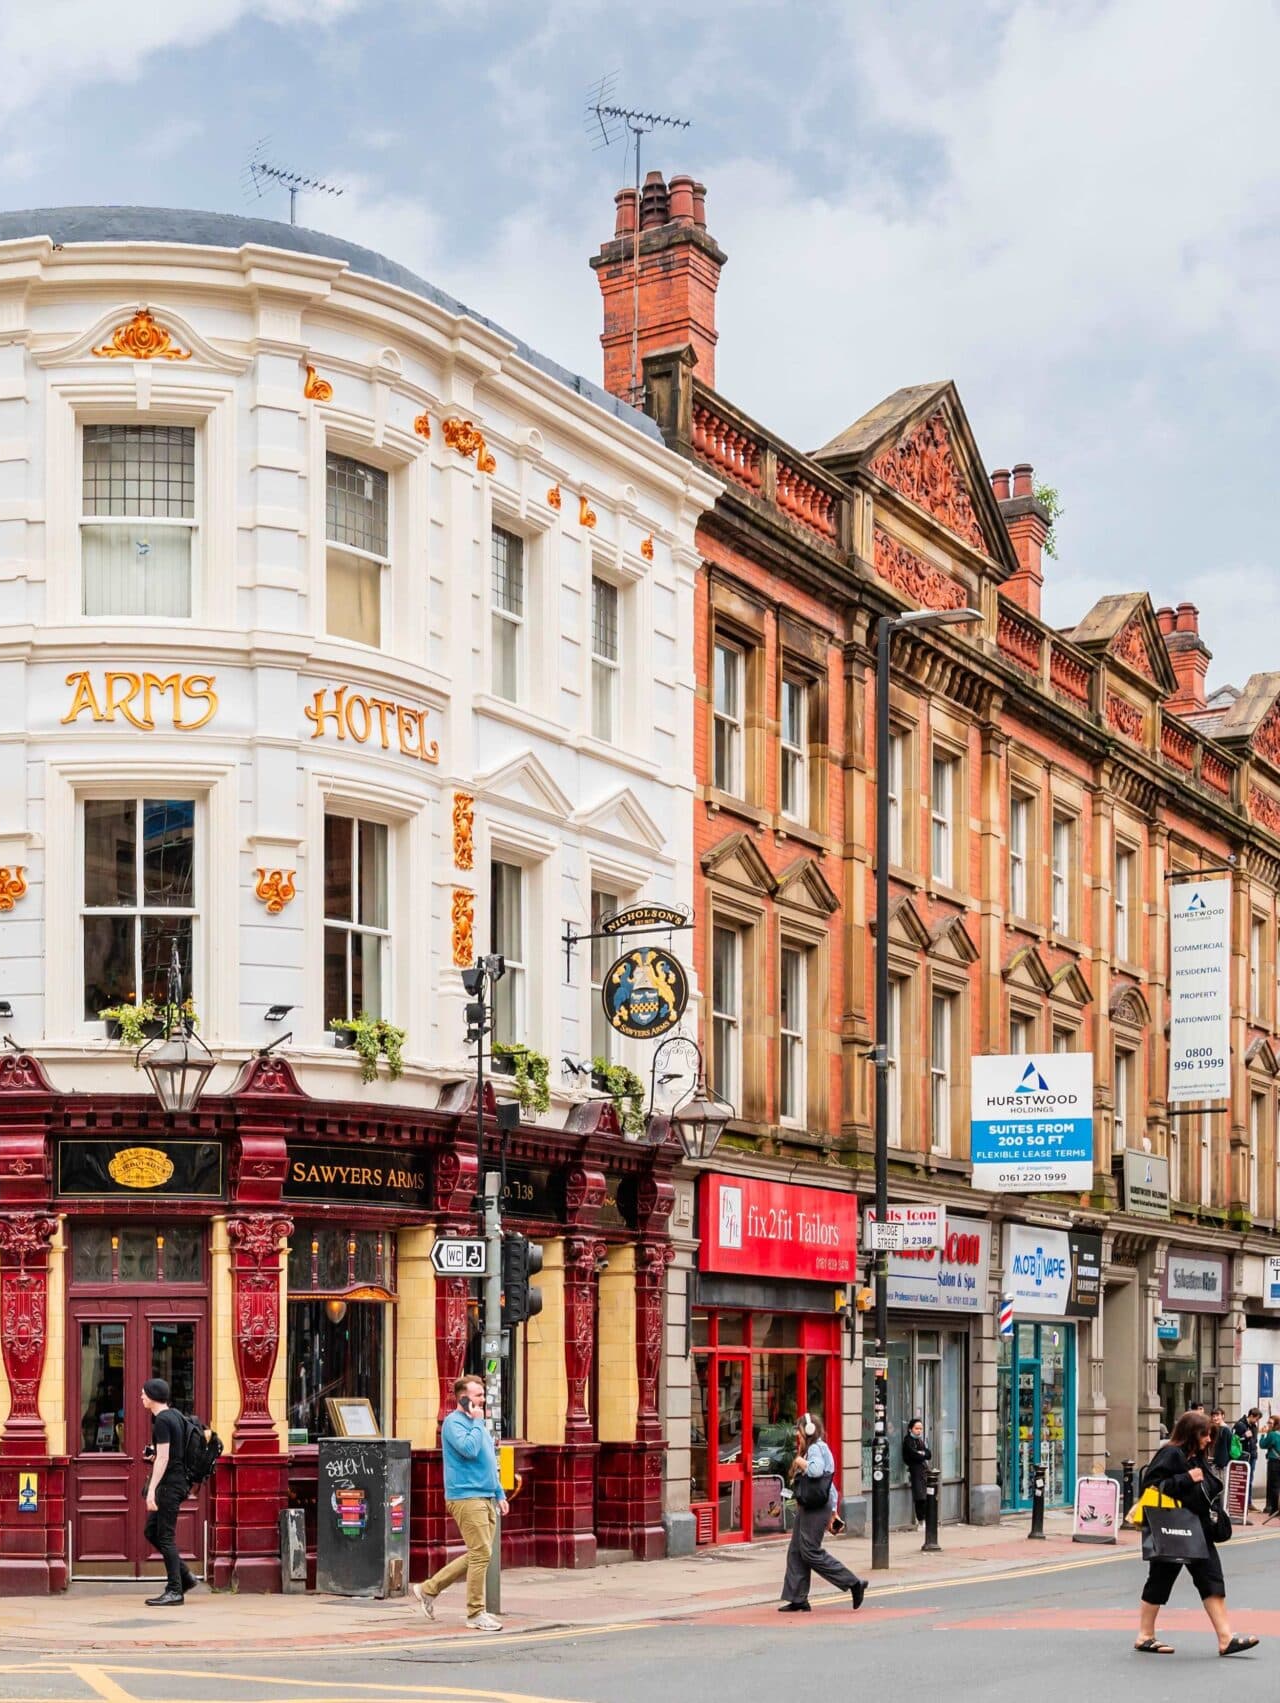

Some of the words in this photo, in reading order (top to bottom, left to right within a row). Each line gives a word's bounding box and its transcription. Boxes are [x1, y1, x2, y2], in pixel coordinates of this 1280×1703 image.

[61, 670, 218, 731] ARMS
[304, 685, 439, 765] HOTEL
[1173, 908, 1224, 920] HURSTWOOD
[607, 910, 681, 931] NICHOLSON'S
[1173, 942, 1224, 953] COMMERCIAL
[1175, 967, 1222, 977] RESIDENTIAL
[1179, 991, 1218, 1000] PROPERTY
[1174, 1014, 1223, 1025] NATIONWIDE
[620, 1024, 651, 1037] SAWYERS
[651, 1021, 671, 1035] ARMS
[1185, 1047, 1213, 1058] 0800
[1173, 1060, 1195, 1071] 996
[1197, 1058, 1224, 1069] 1999
[986, 1095, 1078, 1106] HURSTWOOD
[1010, 1106, 1054, 1114] HOLDINGS
[988, 1124, 1034, 1135] SUITES
[1036, 1123, 1075, 1133] FROM
[998, 1137, 1024, 1146] 200
[1026, 1136, 1045, 1145] SQ
[1048, 1135, 1064, 1145] FT
[976, 1151, 1020, 1159] FLEXIBLE
[1022, 1150, 1052, 1158] LEASE
[1055, 1149, 1086, 1157] TERMS
[292, 1162, 382, 1185] SAWYERS
[386, 1167, 425, 1190] ARMS
[999, 1174, 1020, 1182] 0161
[1022, 1173, 1041, 1181] 220
[1044, 1173, 1067, 1181] 1999
[513, 1181, 534, 1200] 138
[906, 1209, 937, 1221] Icon
[747, 1205, 793, 1241] fix2fit
[796, 1212, 840, 1247] Tailors
[877, 1225, 898, 1236] BRIDGE
[877, 1238, 898, 1249] STREET
[942, 1221, 980, 1264] Icon
[448, 1250, 462, 1262] WC
[937, 1271, 956, 1287] Salon
[964, 1272, 976, 1291] Spa
